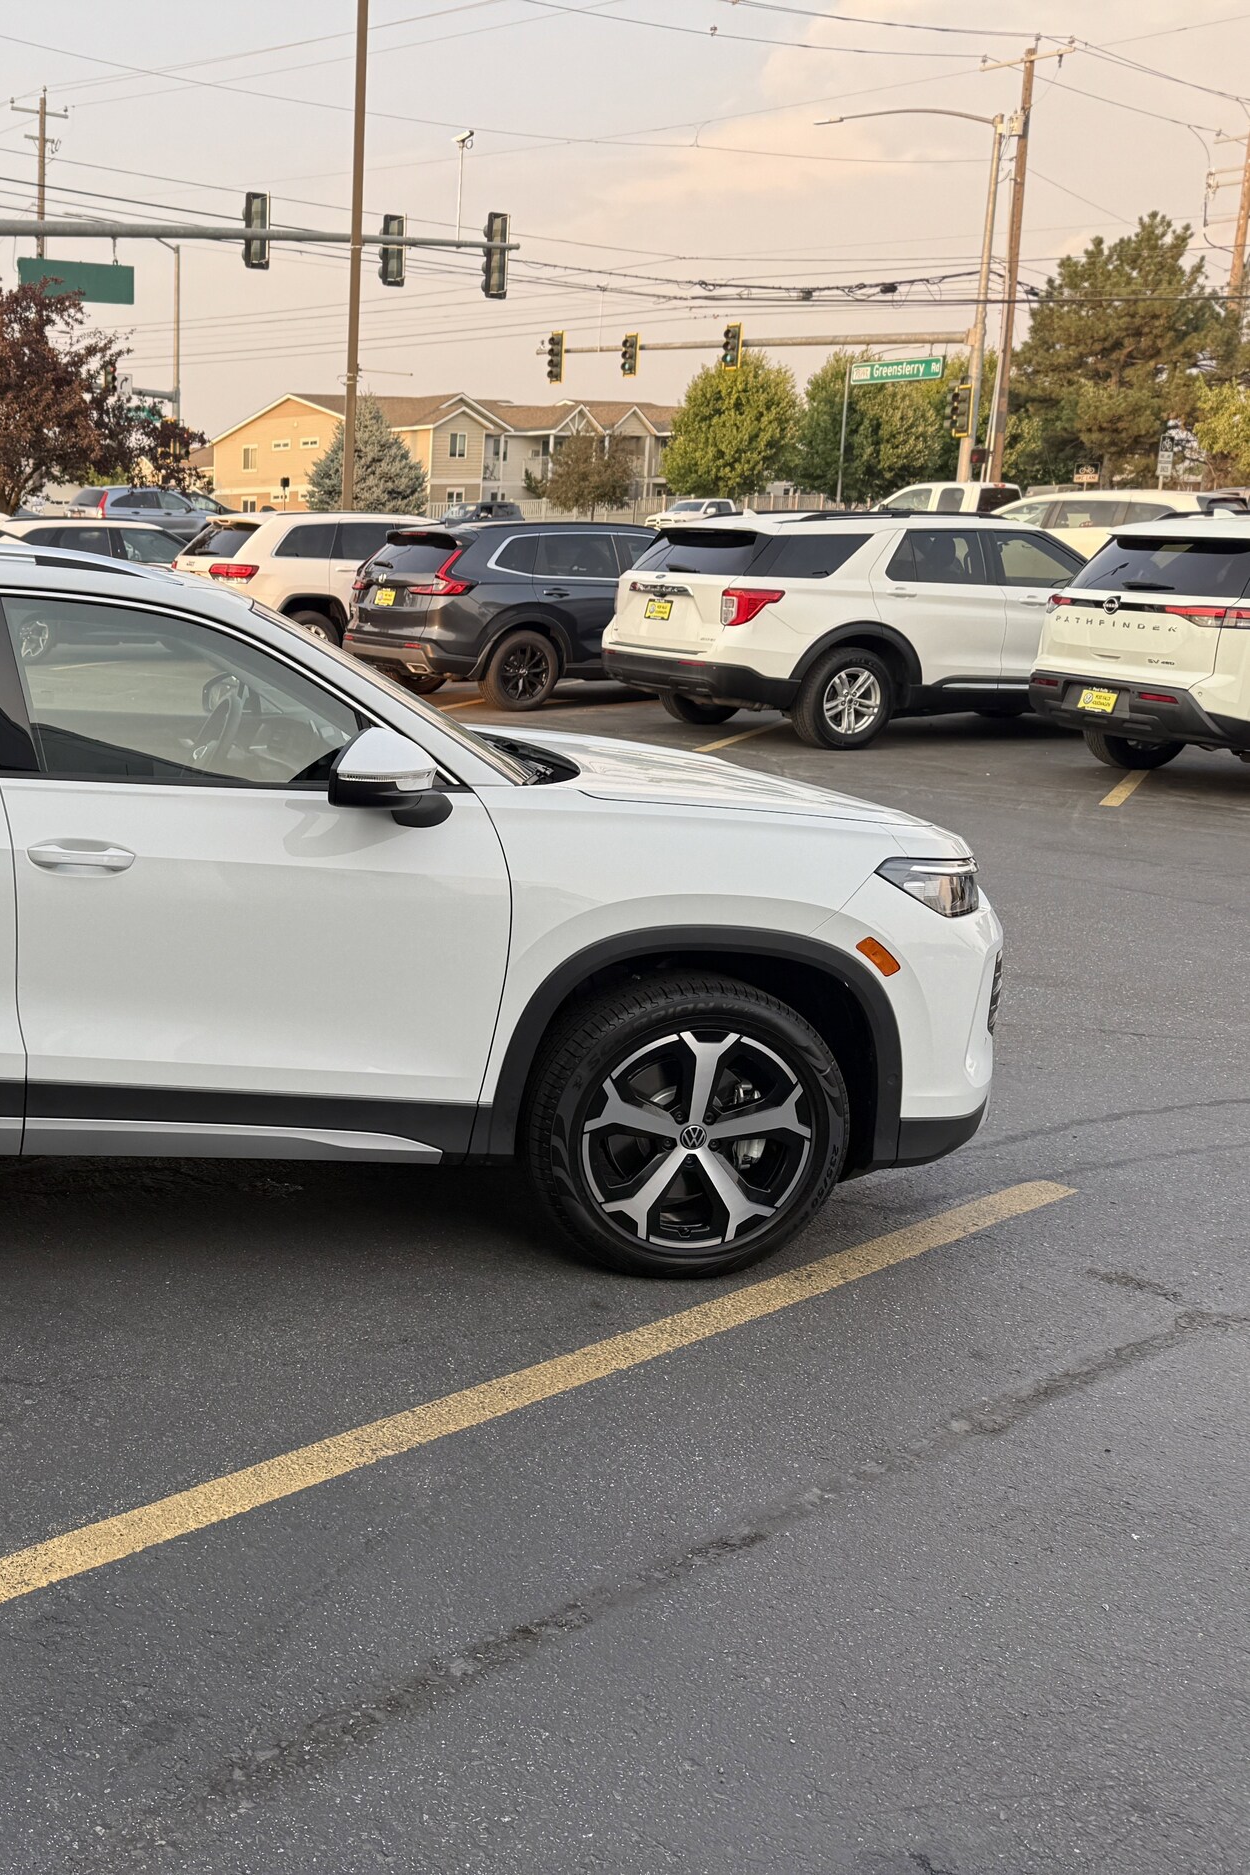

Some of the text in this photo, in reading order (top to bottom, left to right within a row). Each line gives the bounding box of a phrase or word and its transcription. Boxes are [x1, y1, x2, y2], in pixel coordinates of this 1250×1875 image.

[873, 361, 925, 378] Greensferry
[931, 362, 940, 373] Rd
[1055, 615, 1178, 633] PATHFINDER
